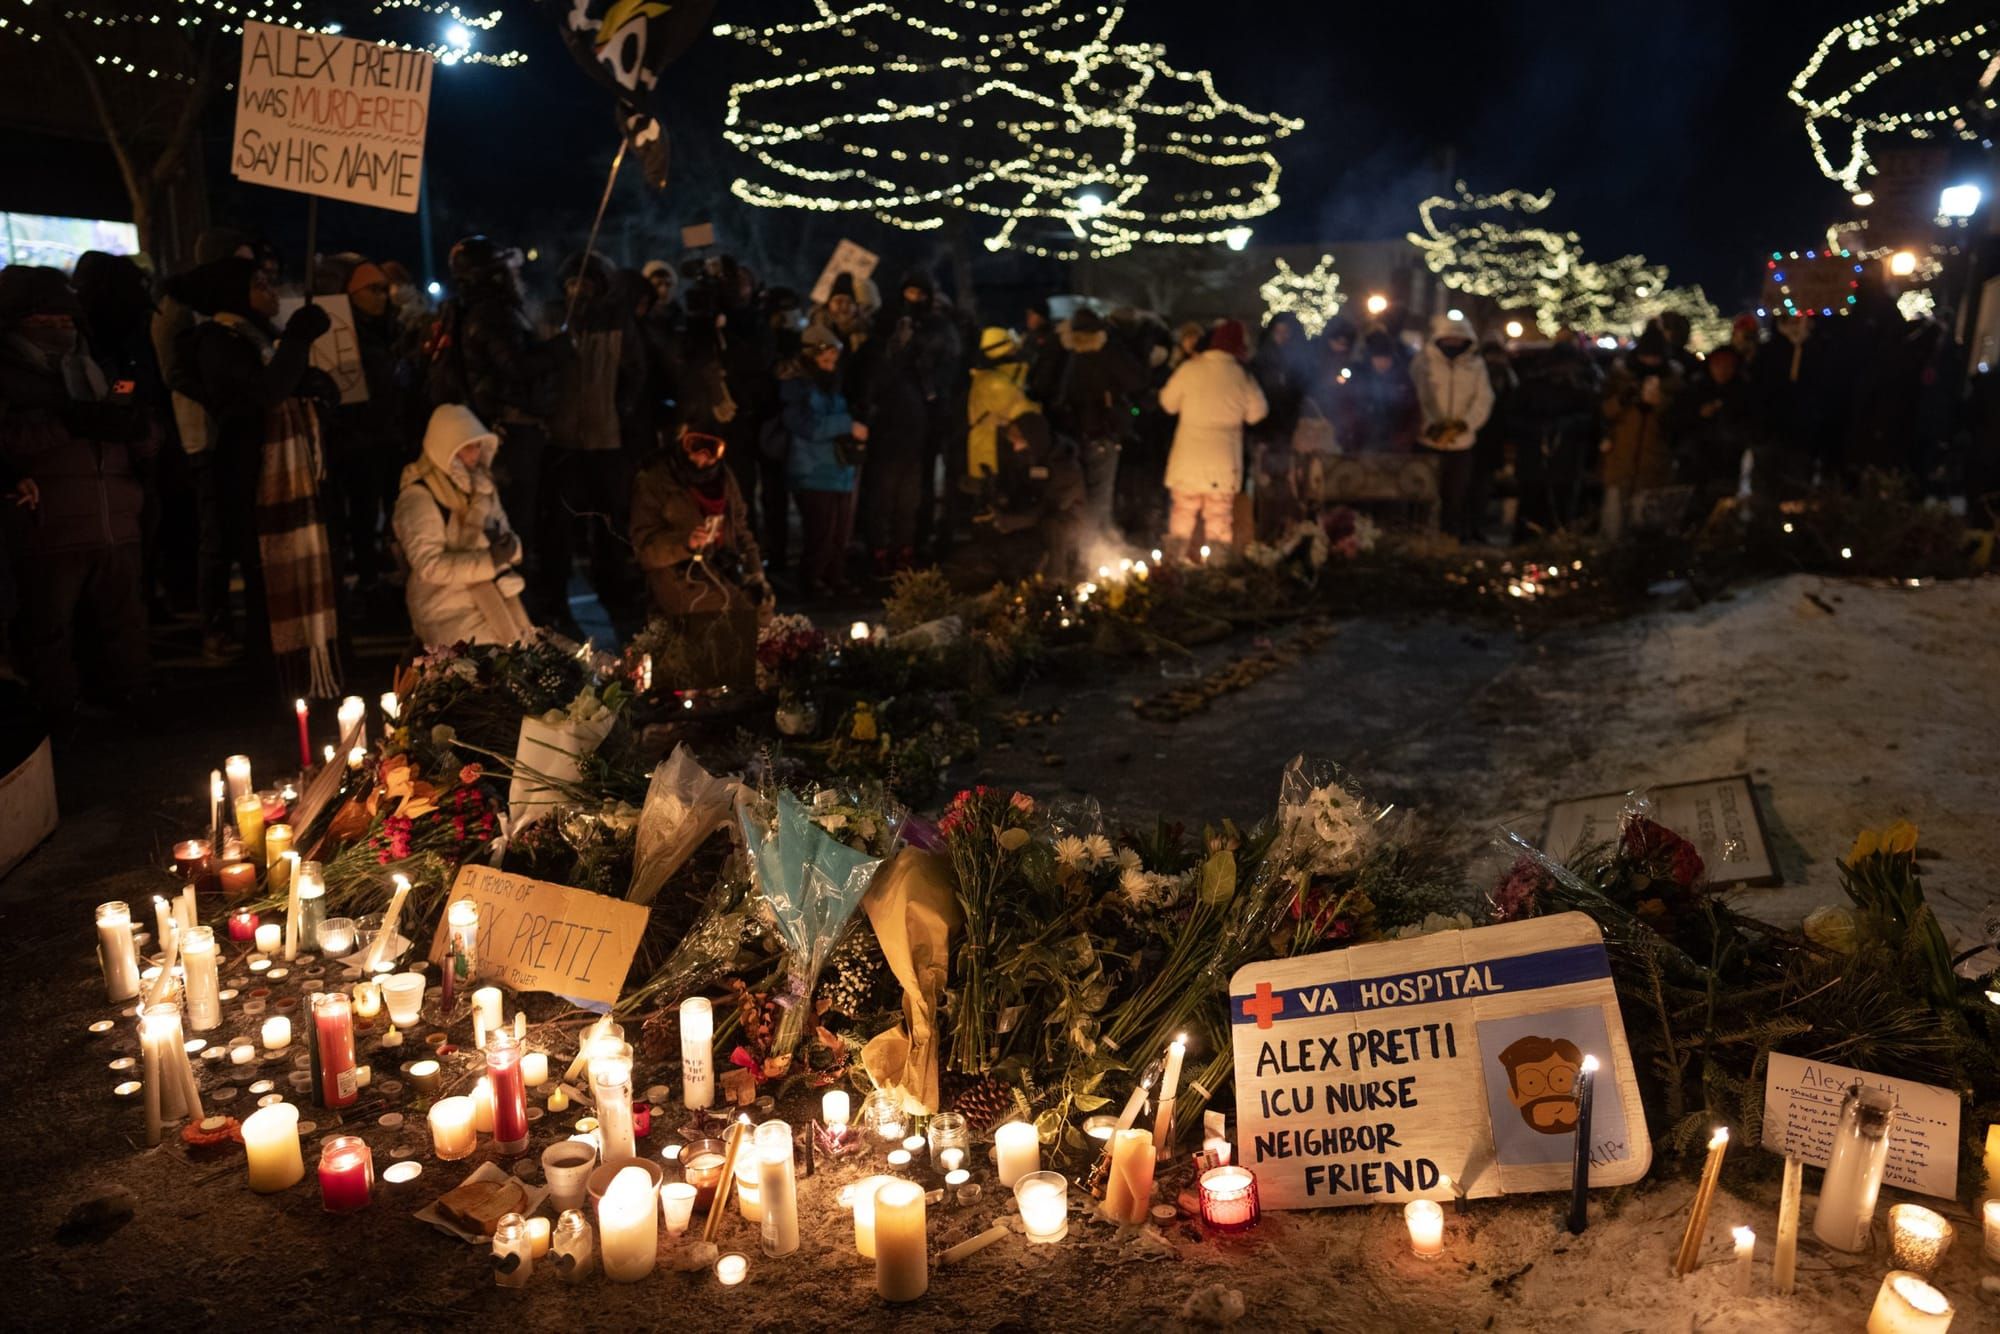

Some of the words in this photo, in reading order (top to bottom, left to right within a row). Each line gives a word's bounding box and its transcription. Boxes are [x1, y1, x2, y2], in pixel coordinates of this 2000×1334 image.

[248, 30, 343, 82] ALEX
[349, 42, 426, 93] PRETTI
[243, 86, 288, 117] WAS
[291, 86, 425, 137] MURDERED
[237, 129, 282, 175] SAY
[285, 137, 328, 184] HIS
[334, 142, 418, 197] NAME
[480, 873, 513, 898] MEMORY
[515, 884, 535, 902] OF
[507, 912, 612, 983] PRETTI
[512, 969, 538, 987] POWER
[1298, 988, 1339, 1013] VA
[1360, 965, 1504, 1007] HOSPITAL
[1256, 1036, 1342, 1077] ALEX
[1349, 1023, 1457, 1070] PRETTI
[1260, 1086, 1313, 1118] ICU
[1326, 1077, 1418, 1115] NURSE
[1801, 1066, 1845, 1091] Alex
[1254, 1122, 1402, 1162] NEIGHBOR
[1305, 1158, 1440, 1197] FRIEND
